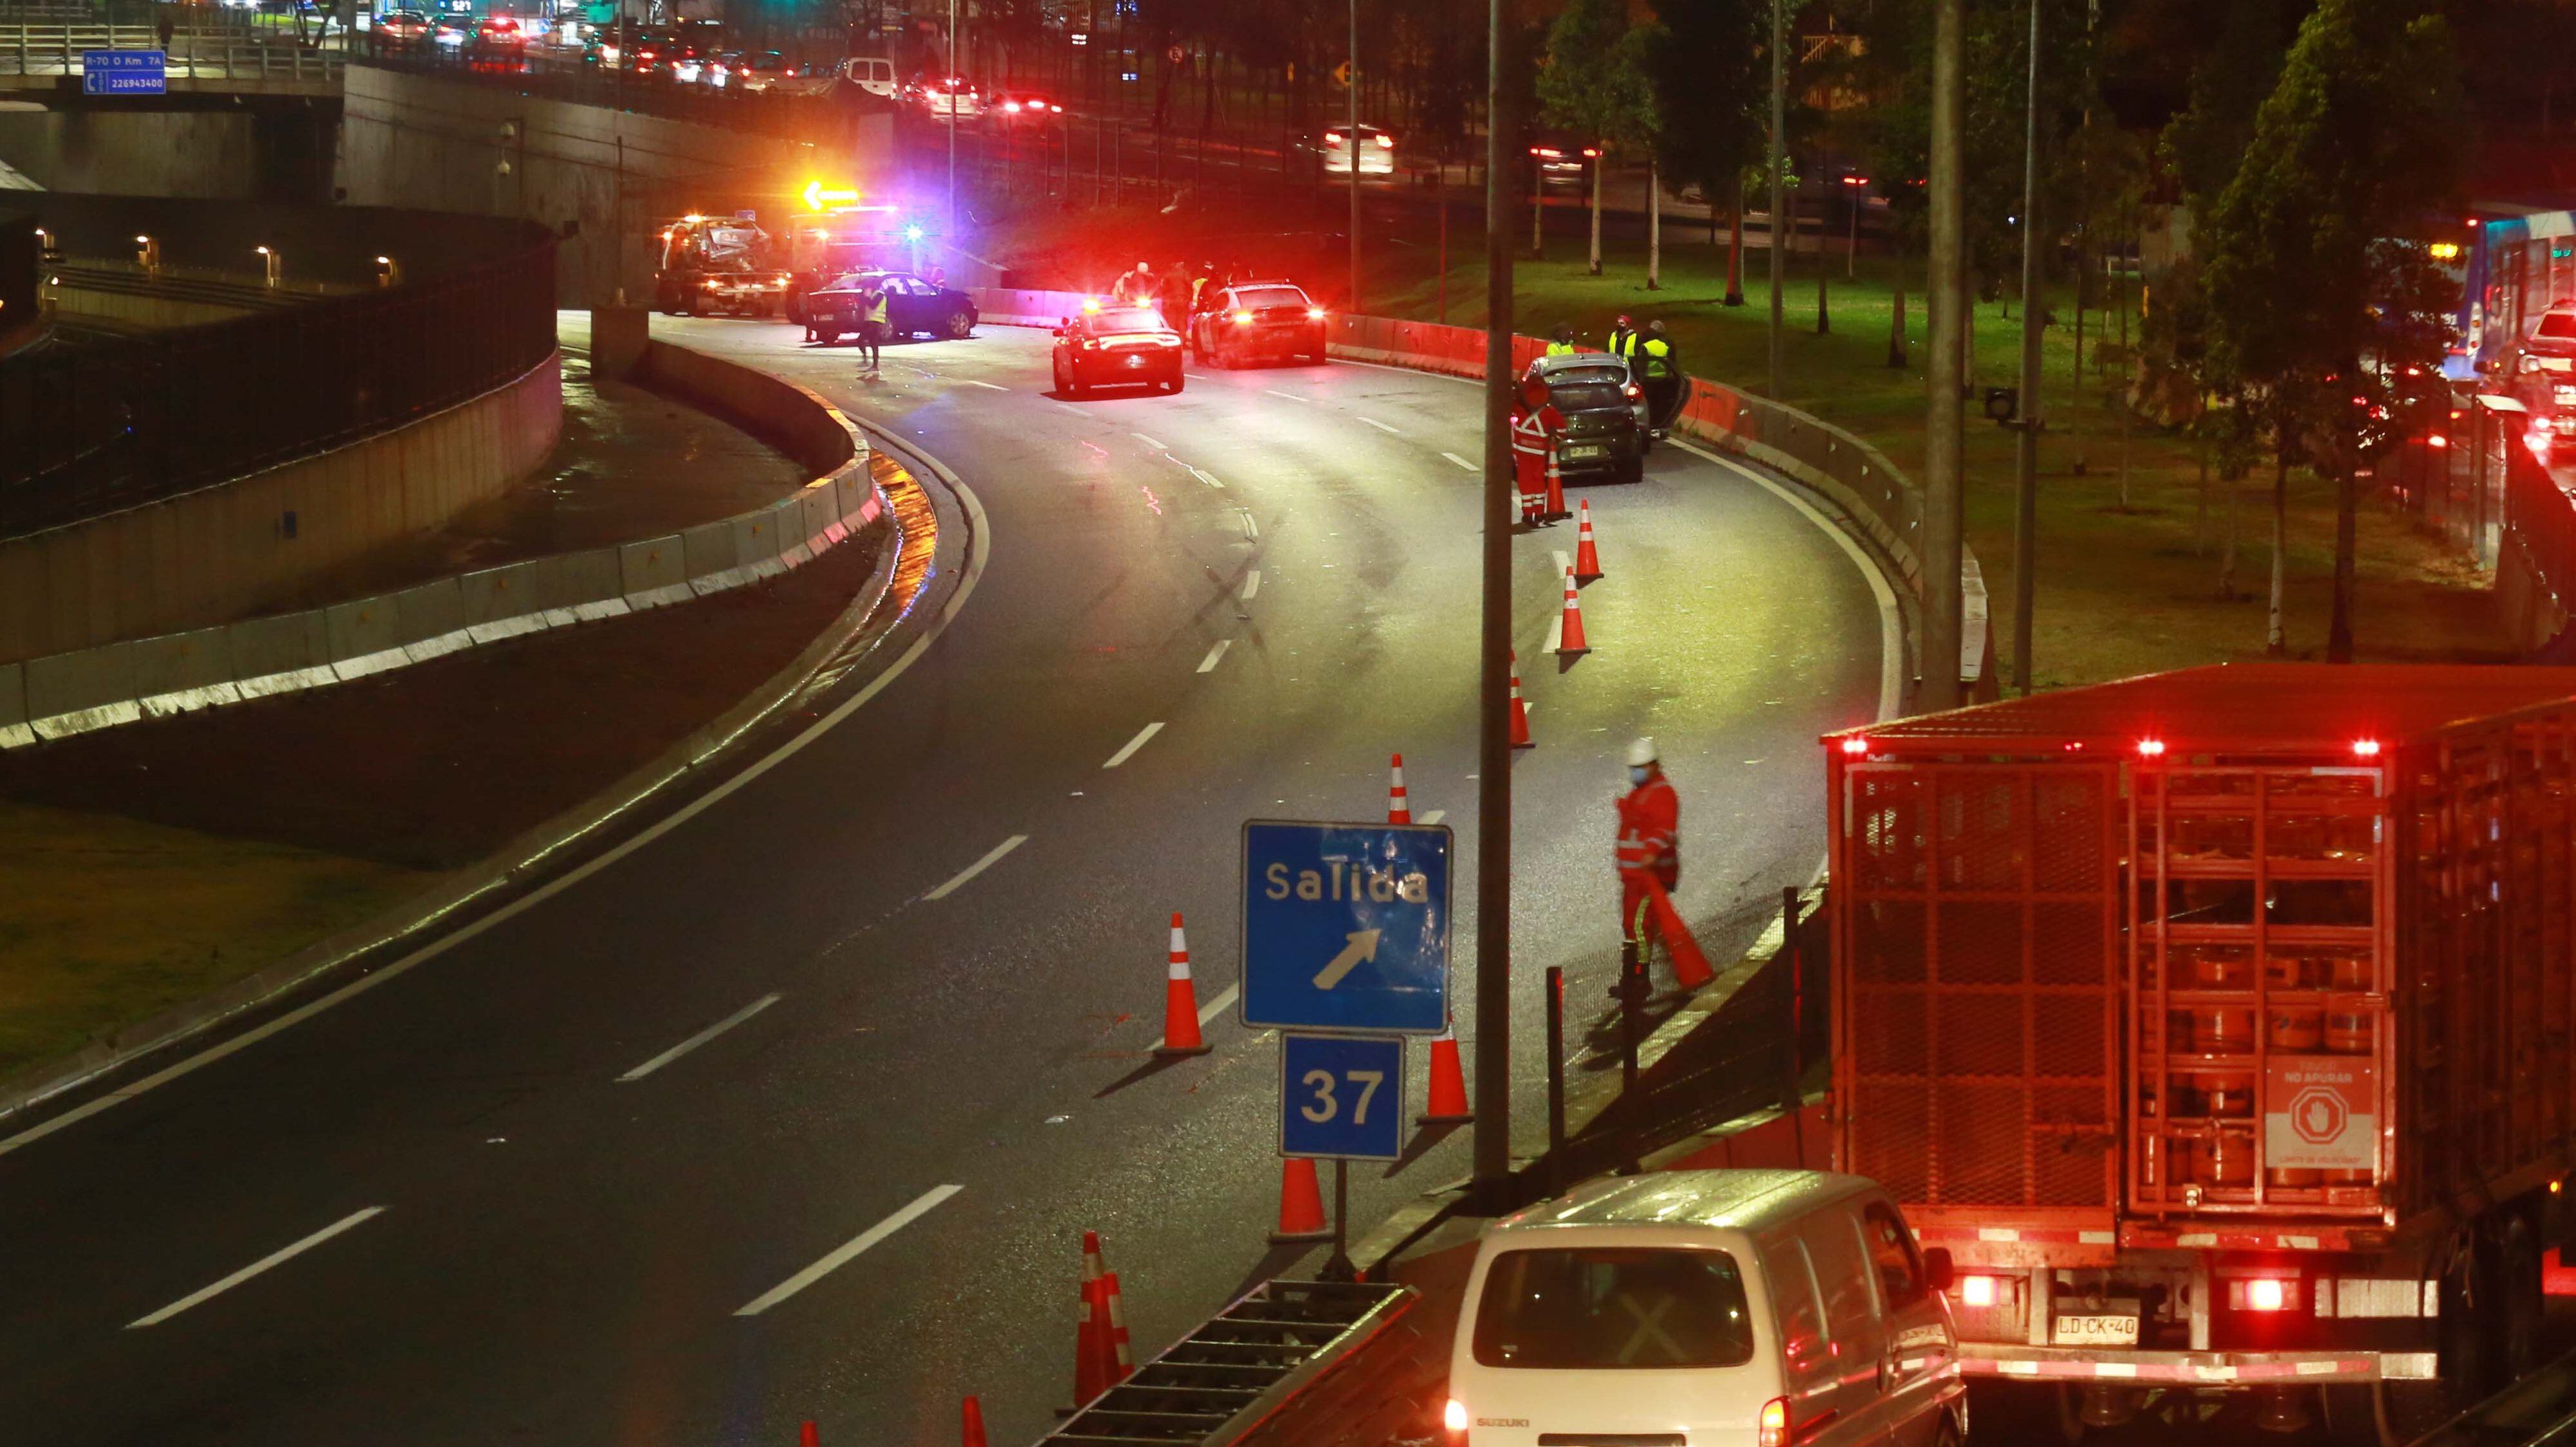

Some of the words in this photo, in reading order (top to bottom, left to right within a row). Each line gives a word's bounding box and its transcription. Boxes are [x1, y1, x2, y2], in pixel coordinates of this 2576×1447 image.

[86, 57, 109, 65] R-70
[125, 57, 142, 65] Km
[148, 56, 161, 65] 7A
[112, 78, 163, 88] 226943400
[1265, 862, 1429, 903] Salida
[2285, 1072, 2302, 1083] NO
[2304, 1072, 2353, 1083] APURAR
[1300, 1069, 1384, 1125] 37
[1477, 1417, 1530, 1428] SUZUKI
